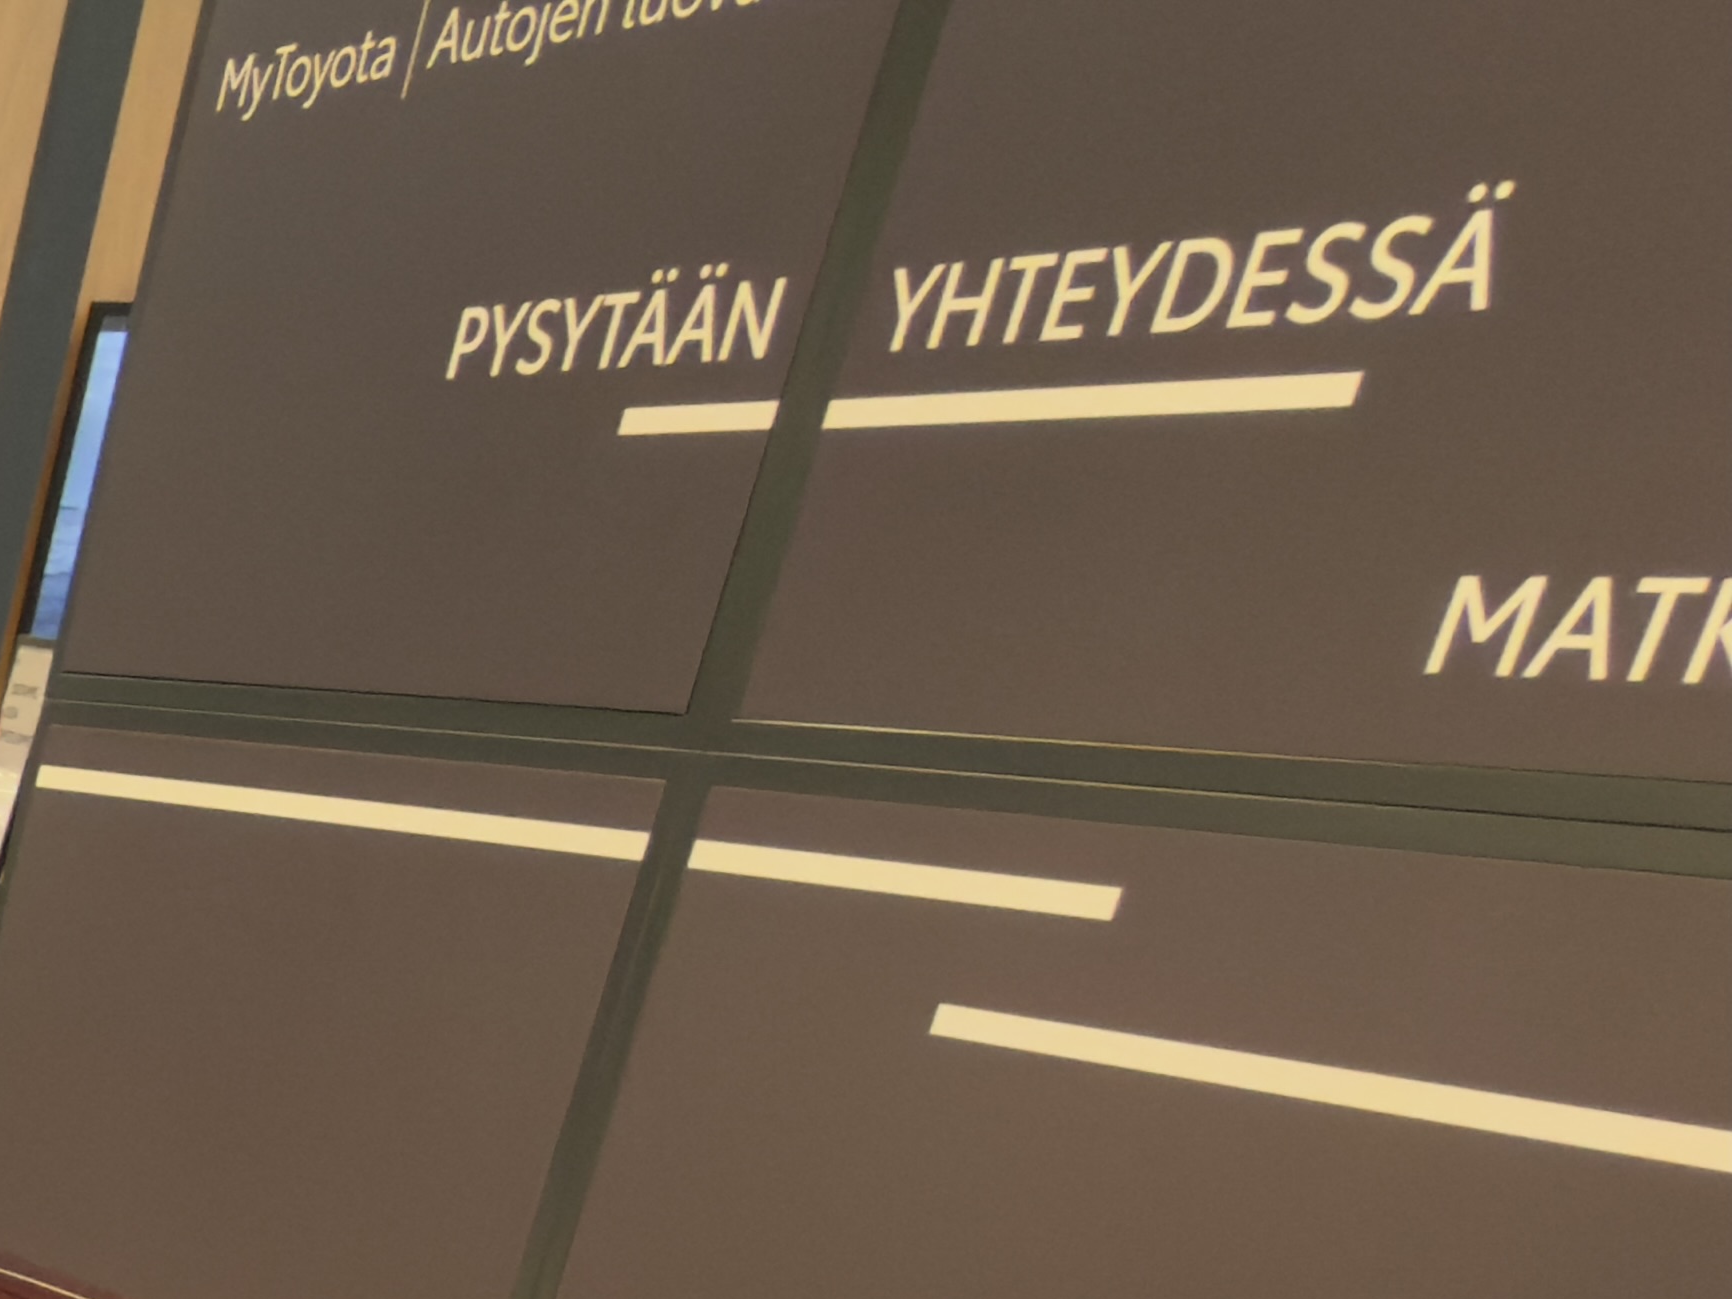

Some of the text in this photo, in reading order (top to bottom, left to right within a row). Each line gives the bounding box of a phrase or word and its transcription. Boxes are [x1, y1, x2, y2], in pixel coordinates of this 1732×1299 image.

[215, 0, 609, 121] MyToyota Autojen
[445, 179, 1516, 380] PYSYTÄÄN YHTEYDESSÄ
